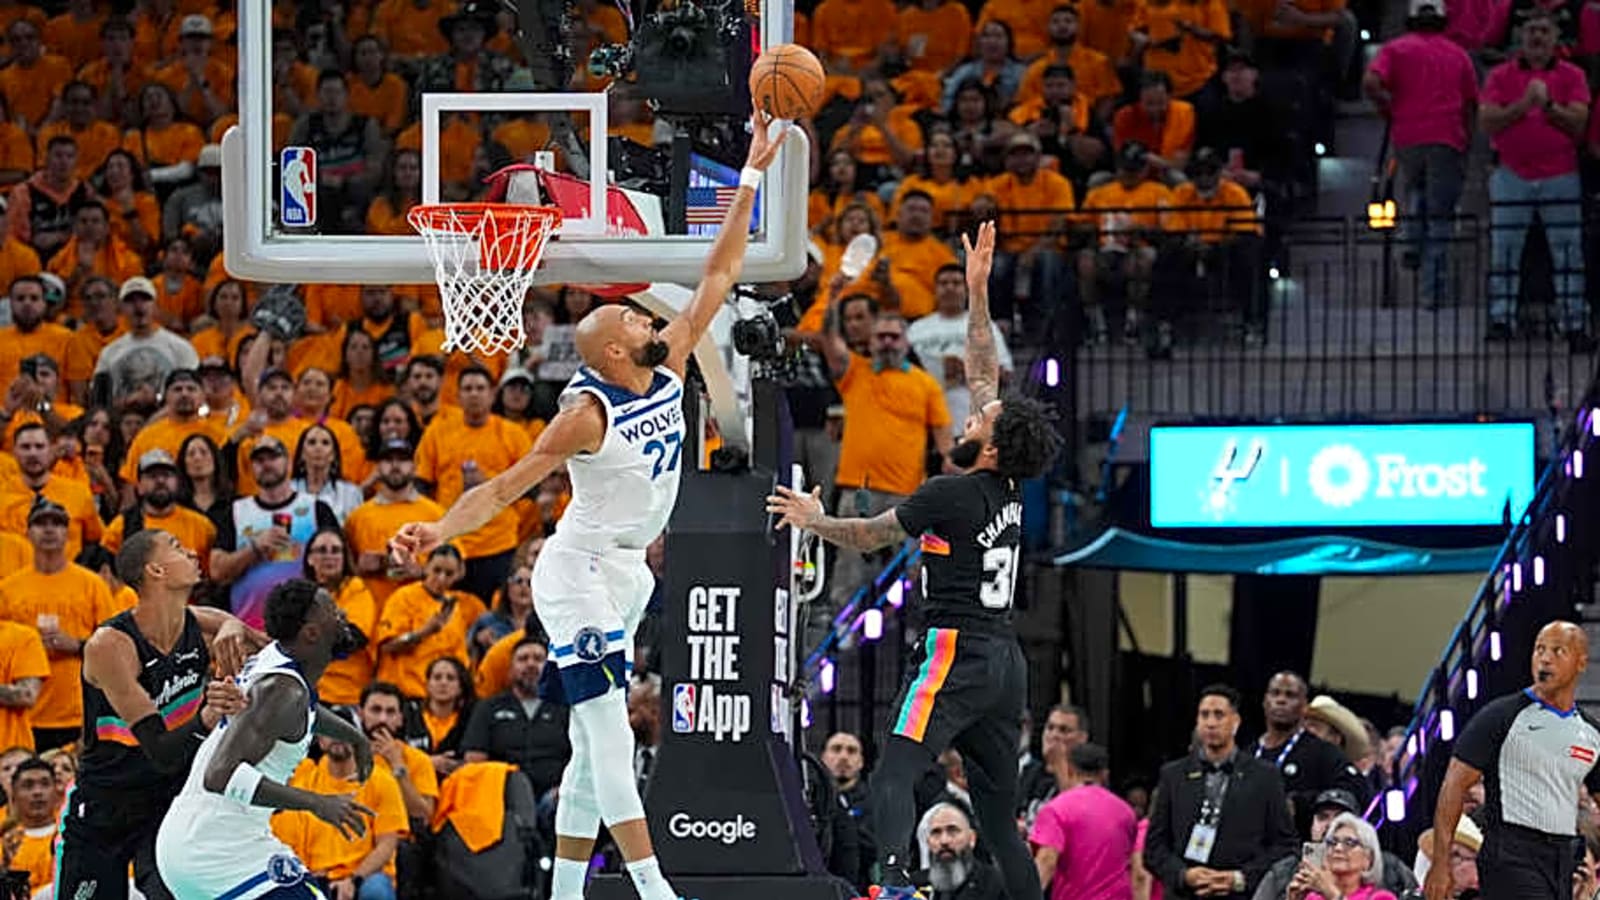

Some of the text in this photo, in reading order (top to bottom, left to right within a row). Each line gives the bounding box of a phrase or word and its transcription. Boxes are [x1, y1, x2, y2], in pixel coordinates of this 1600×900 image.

[642, 430, 683, 481] 27
[1375, 454, 1488, 497] Frost
[688, 586, 741, 632] GET
[687, 635, 741, 681] THE
[697, 684, 751, 742] App
[669, 813, 756, 844] Google
